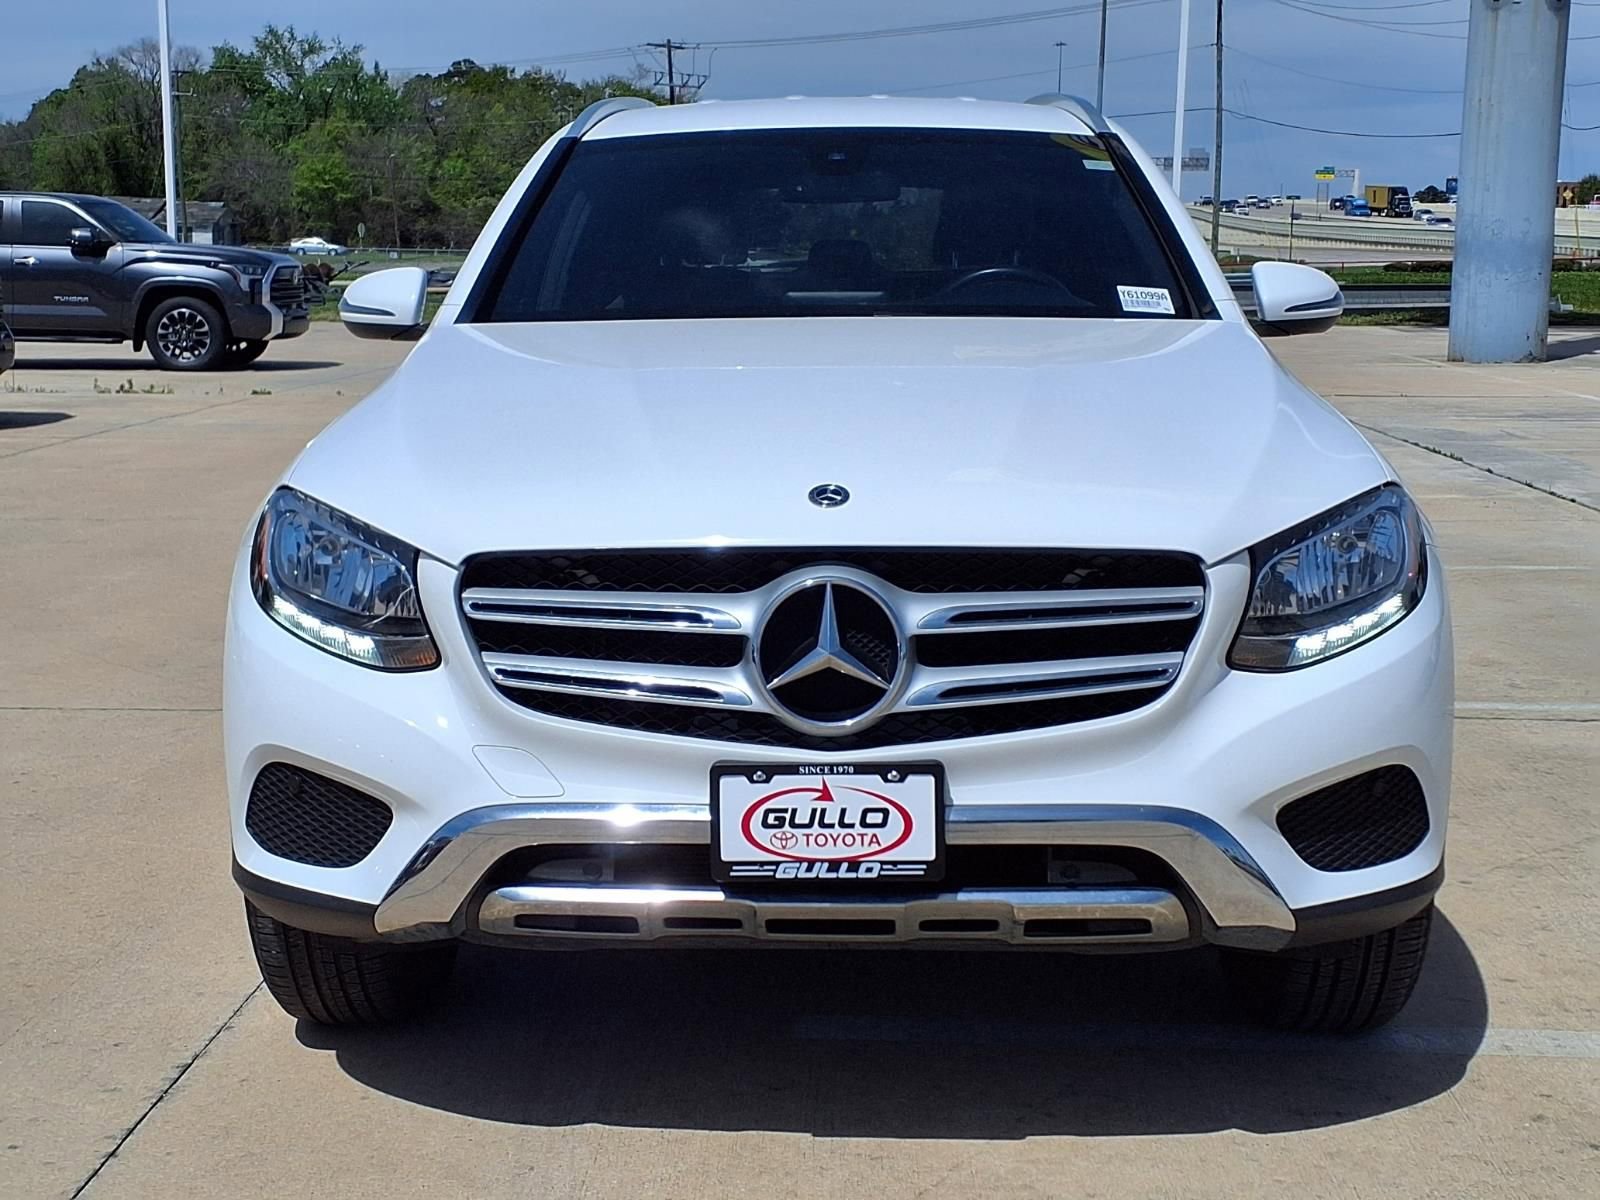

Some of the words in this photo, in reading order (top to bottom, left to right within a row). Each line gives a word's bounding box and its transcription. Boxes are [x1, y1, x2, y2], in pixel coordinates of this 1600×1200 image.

[1120, 290, 1168, 301] Y61099A
[799, 765, 831, 774] SINCE
[833, 765, 854, 774] 1970
[761, 807, 891, 830] GULLO
[802, 833, 882, 847] TOYOTA
[775, 862, 881, 879] GULLO
